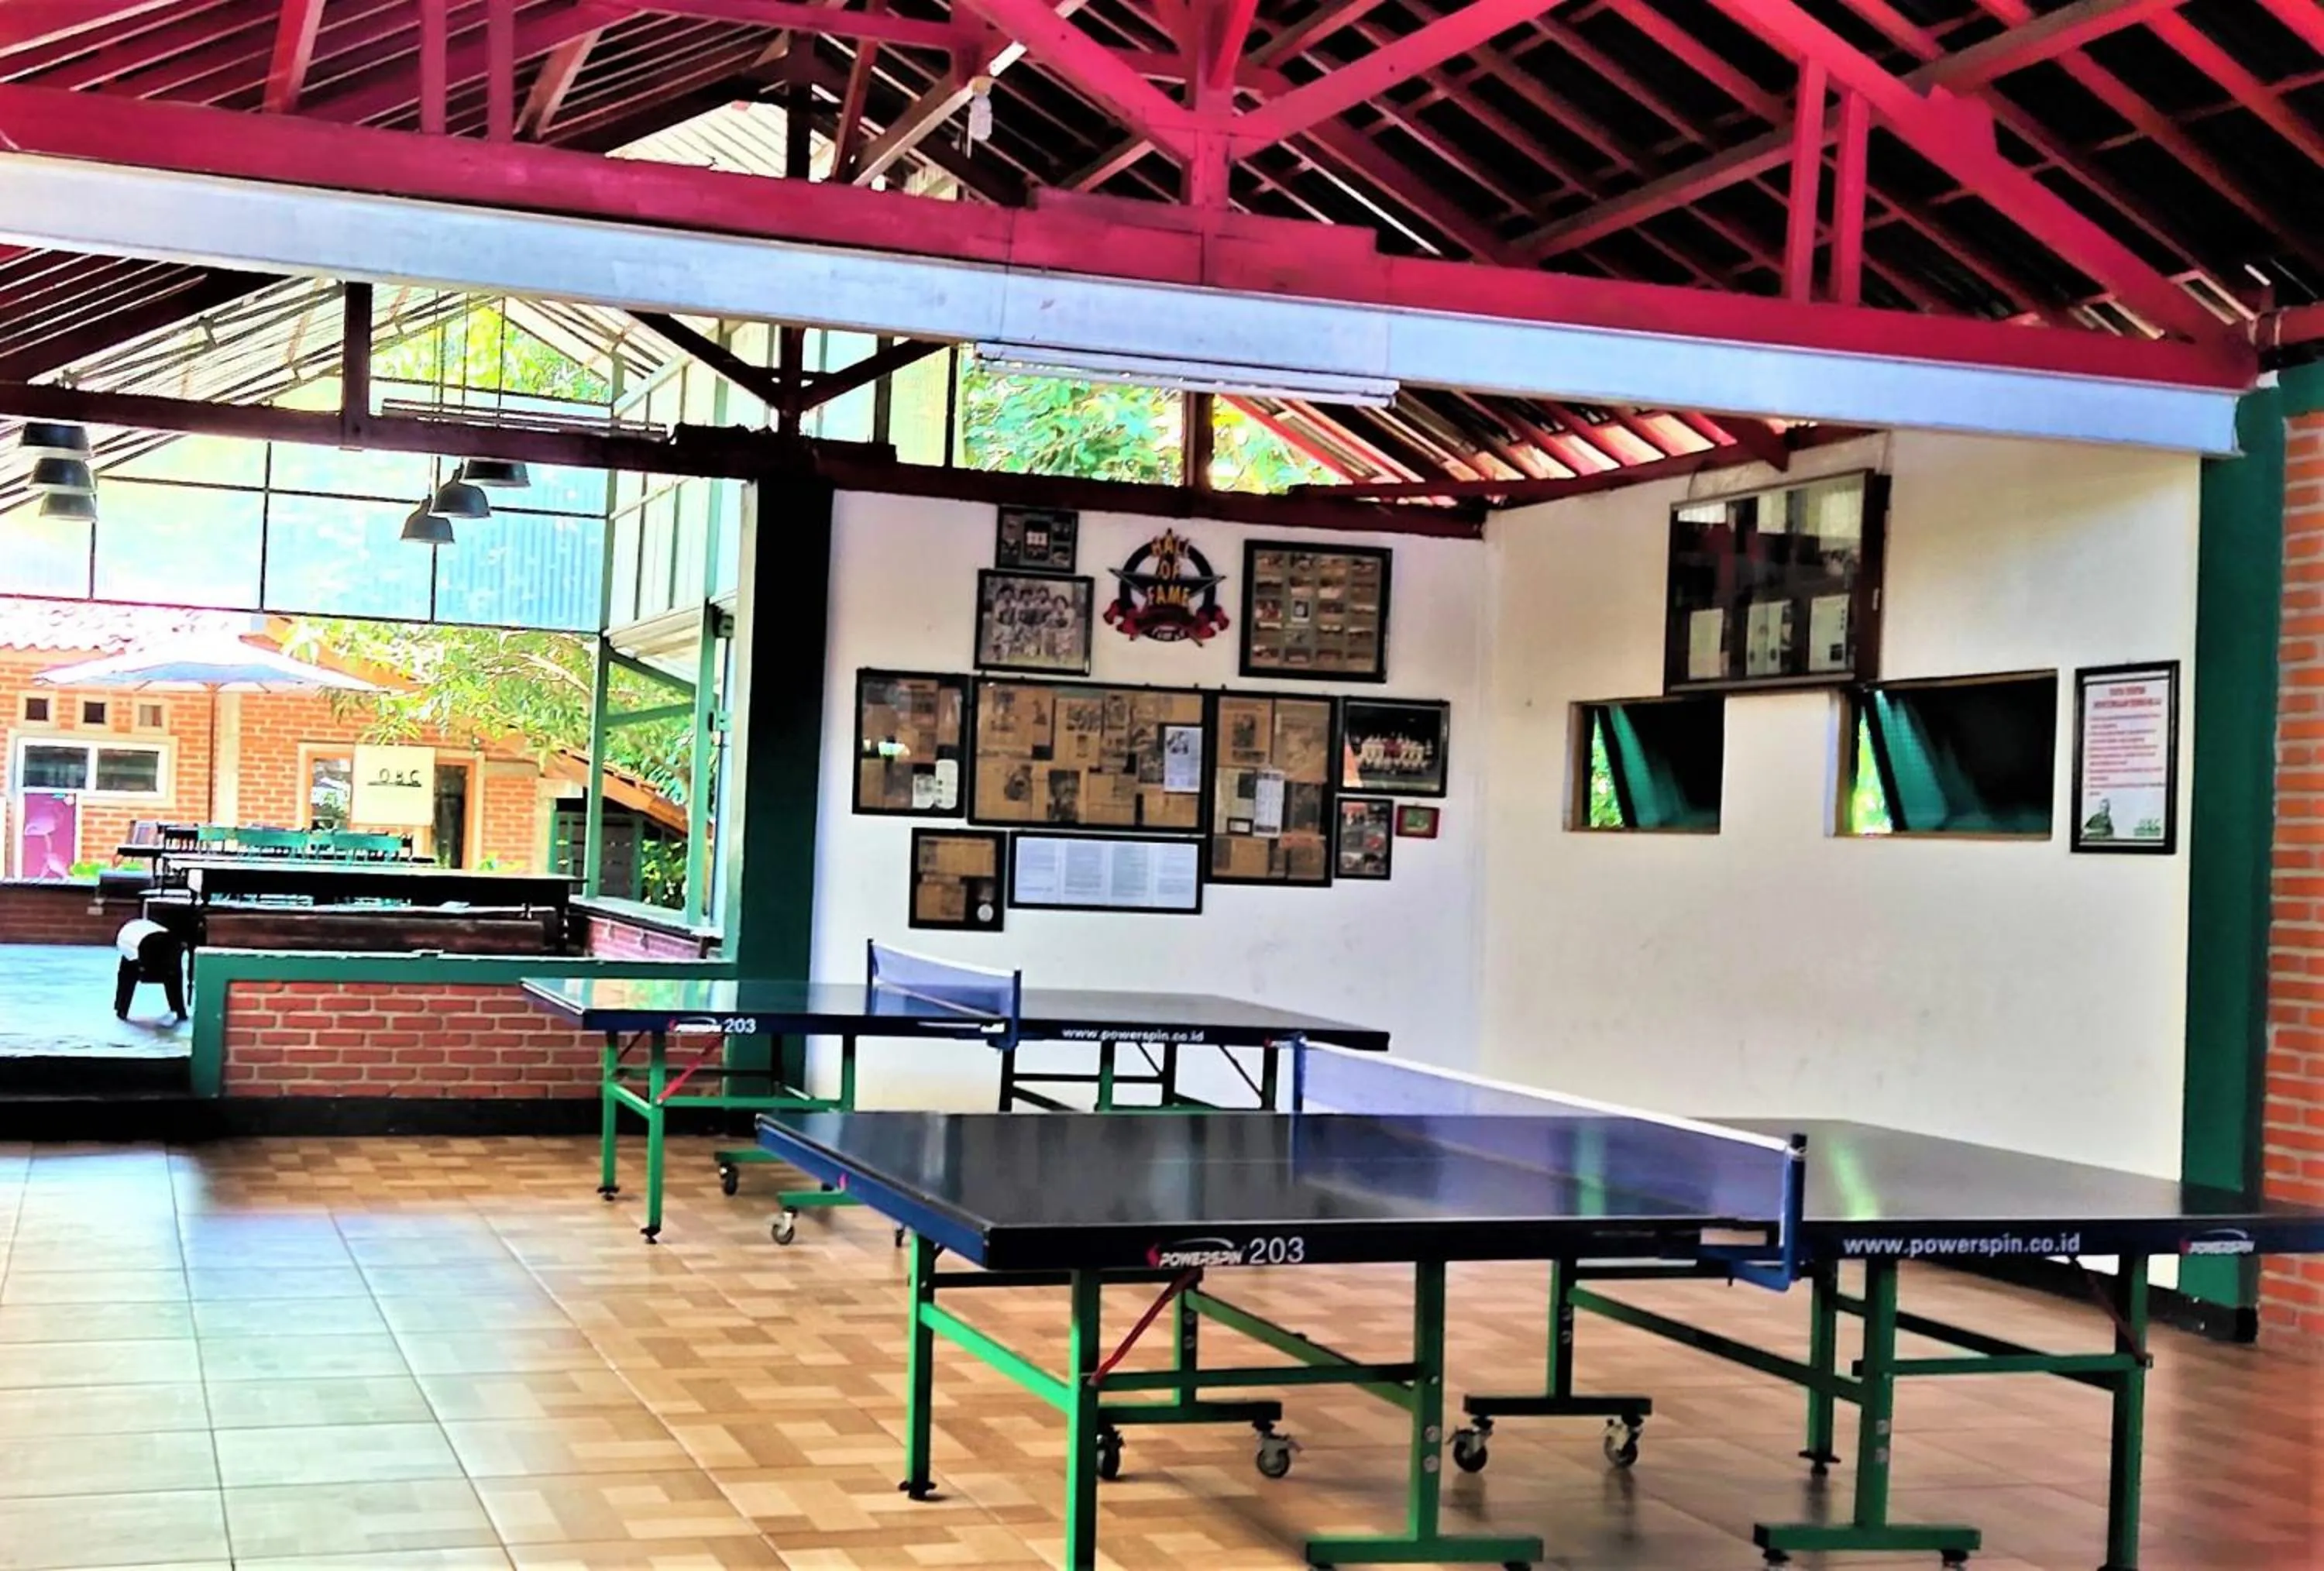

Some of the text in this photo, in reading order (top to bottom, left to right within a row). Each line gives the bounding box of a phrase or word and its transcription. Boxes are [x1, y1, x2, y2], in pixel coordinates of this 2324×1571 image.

[1147, 584, 1191, 607] FAME
[723, 1017, 757, 1033] 203
[1062, 1029, 1205, 1043] www.powerspin.co.id
[1159, 1236, 1305, 1267] POWERSPIN 203
[1844, 1232, 2081, 1257] www.powerspin.co.id
